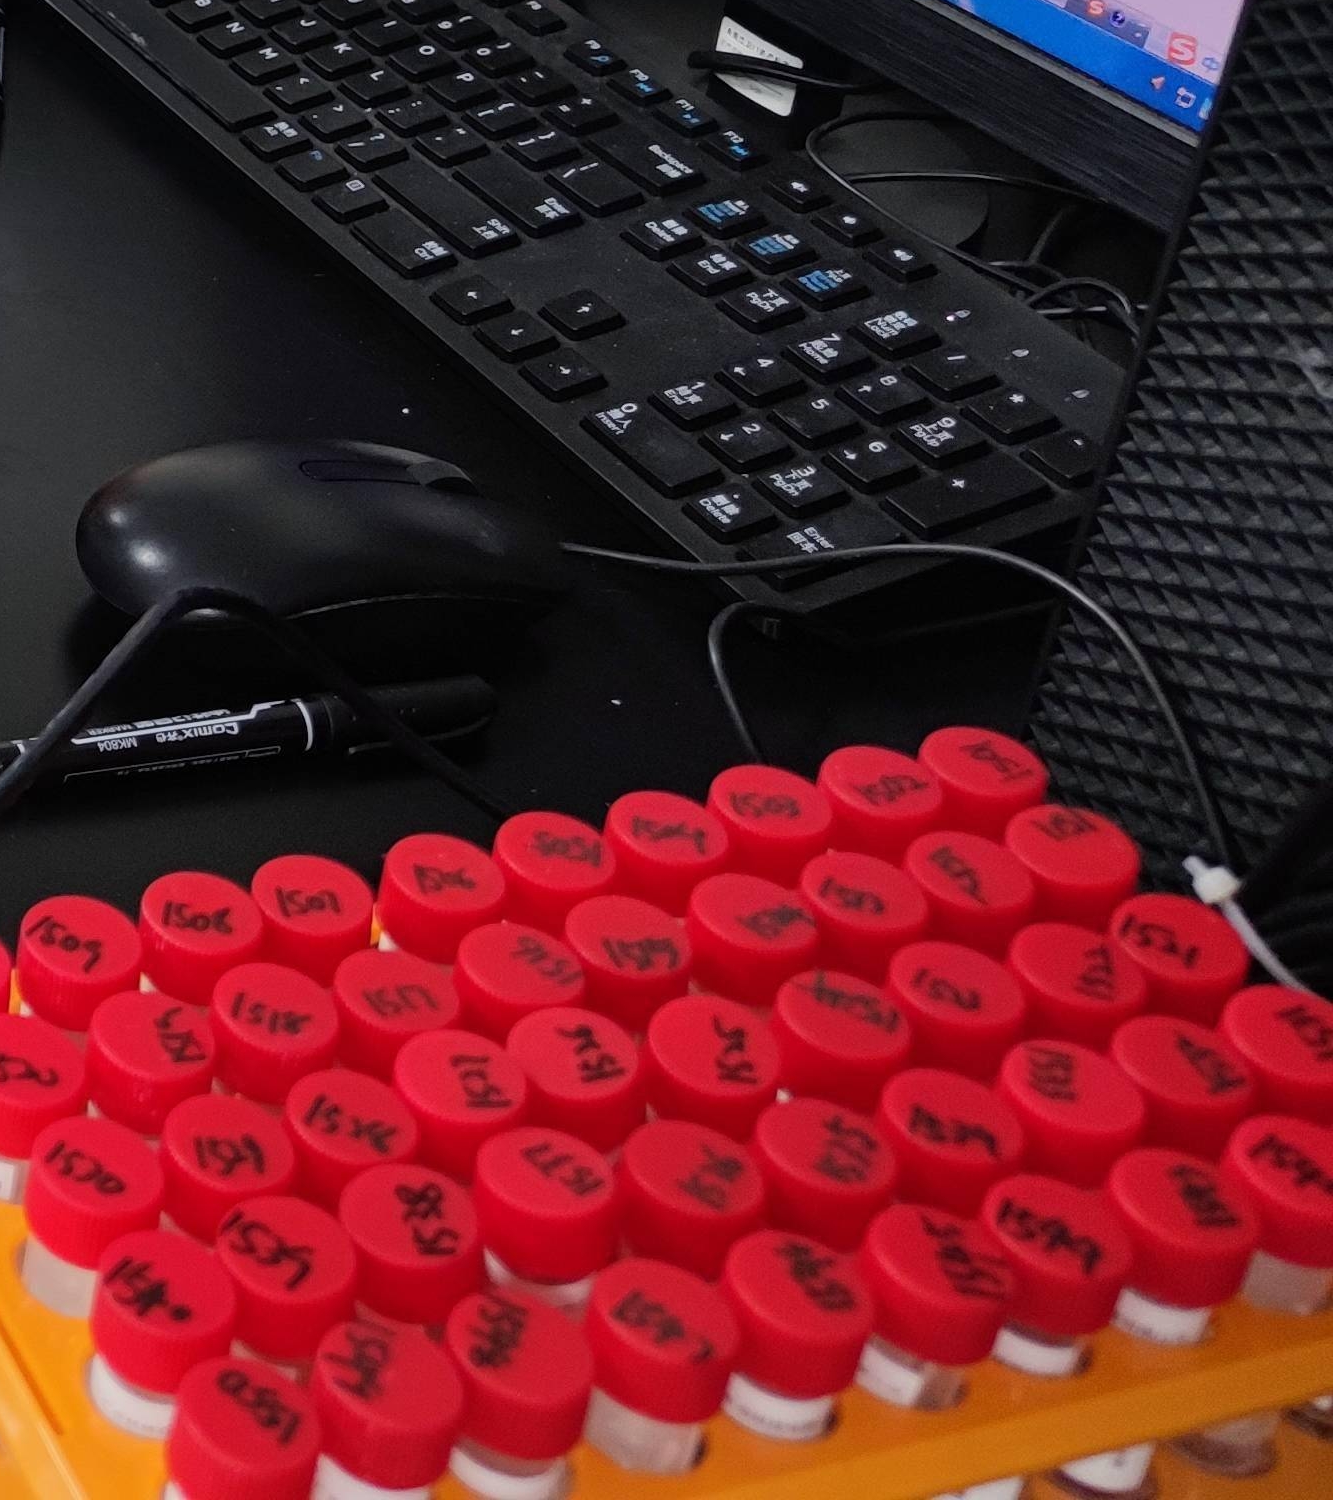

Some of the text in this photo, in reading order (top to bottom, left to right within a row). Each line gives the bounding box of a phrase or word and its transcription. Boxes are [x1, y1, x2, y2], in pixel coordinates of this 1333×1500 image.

[227, 22, 244, 32] N
[334, 43, 351, 53] K
[419, 46, 435, 55] O
[259, 48, 278, 59] M
[371, 71, 383, 80] L
[457, 73, 474, 81] P
[812, 399, 829, 409] 5
[742, 424, 760, 434] 2
[869, 442, 886, 452] 6
